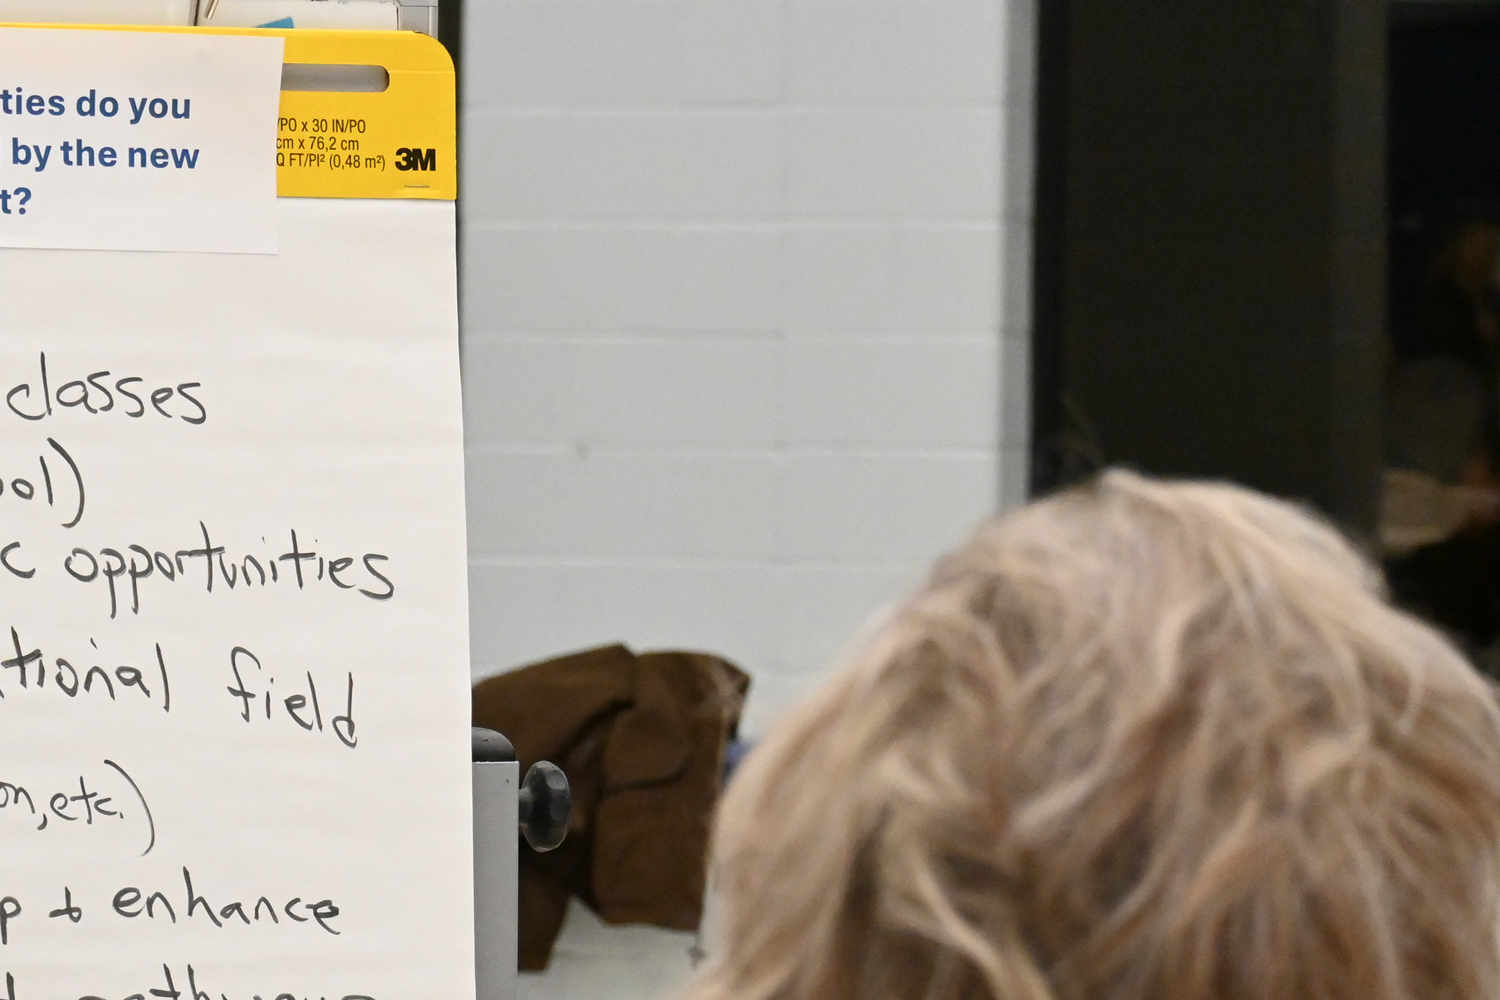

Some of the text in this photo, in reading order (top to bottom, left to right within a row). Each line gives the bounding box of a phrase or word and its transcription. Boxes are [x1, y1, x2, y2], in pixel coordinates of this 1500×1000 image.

[75, 88, 120, 118] do
[127, 97, 191, 126] you
[298, 140, 305, 150] x
[309, 137, 337, 153] 76,2
[341, 139, 359, 150] cm
[301, 122, 308, 132] x
[312, 119, 328, 133] 30
[332, 119, 366, 134] IN/PO
[11, 136, 53, 173] by
[59, 138, 118, 168] the
[128, 147, 200, 170] new
[329, 155, 361, 171] (0,48
[395, 147, 437, 171] 3M
[6, 351, 207, 425] classes
[61, 517, 395, 620] opportunities
[226, 646, 358, 749] field
[112, 865, 341, 936] enhance
